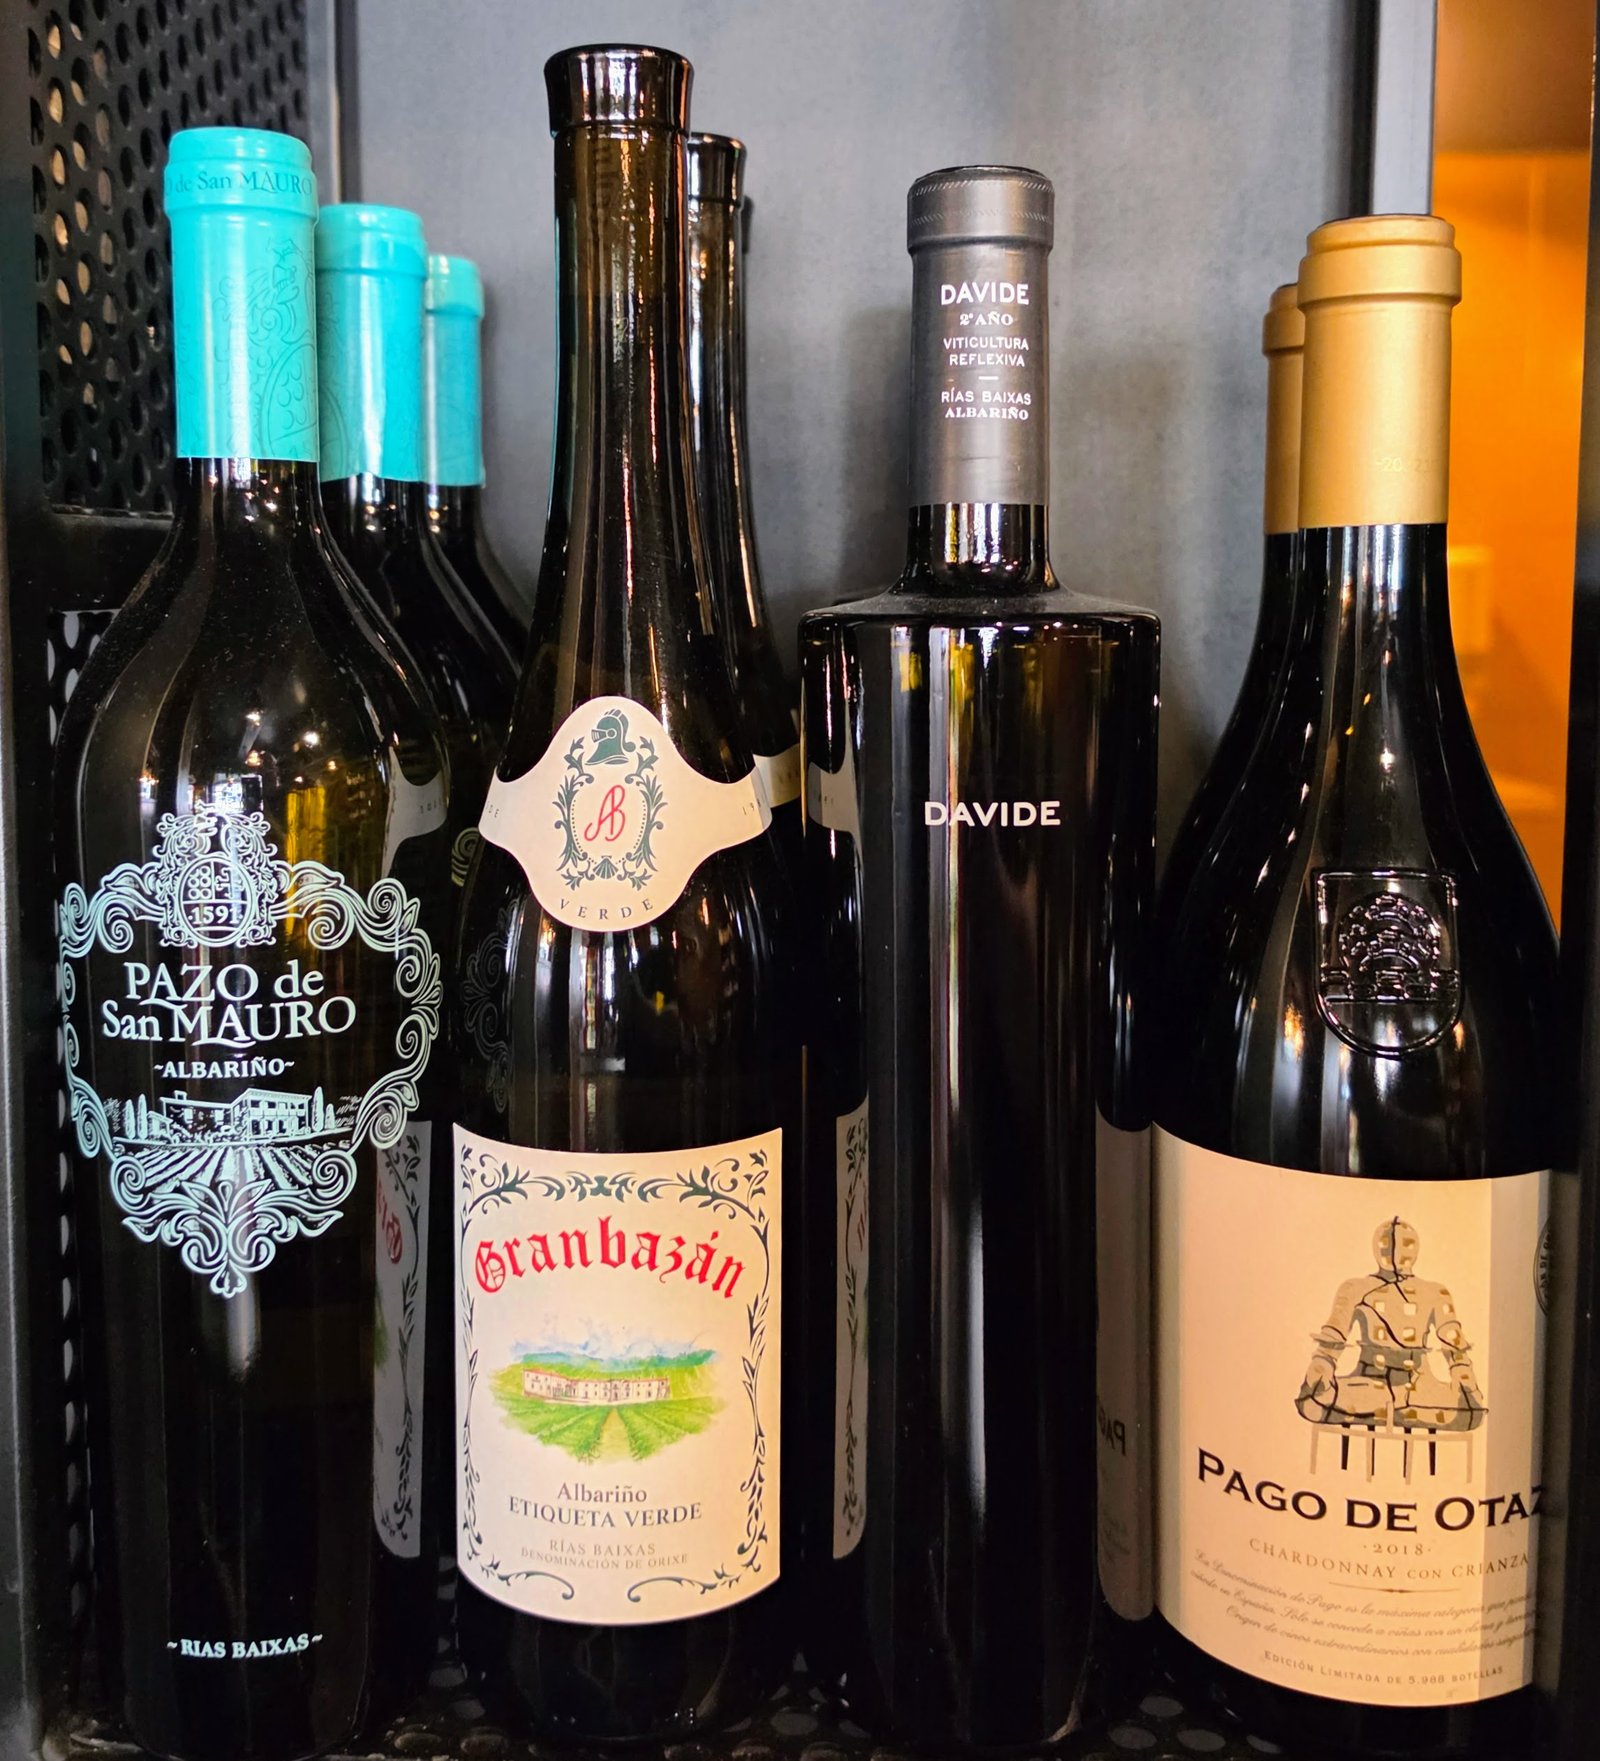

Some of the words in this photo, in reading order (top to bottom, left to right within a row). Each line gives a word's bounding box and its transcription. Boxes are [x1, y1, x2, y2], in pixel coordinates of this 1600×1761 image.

[176, 173, 192, 193] de
[197, 170, 232, 191] San
[240, 171, 313, 196] MAURO
[941, 281, 1029, 306] DAVIDE
[975, 310, 1014, 326] AÑO
[943, 336, 1029, 351] VITICULTURA
[949, 354, 1025, 367] REFLEXIVA
[941, 386, 975, 403] RÍAS
[982, 391, 1031, 405] BAIXAS
[945, 406, 1029, 420] ALBARIÑO
[924, 801, 1061, 827] DAVIDE
[558, 898, 654, 921] VERDE
[123, 962, 259, 1008] PAZO
[274, 959, 324, 999] de
[102, 1000, 163, 1042] San
[167, 996, 356, 1049] MAURO
[475, 1215, 747, 1299] Granbazán
[557, 1482, 648, 1504] Albariño
[1198, 1447, 1328, 1521] PAGO
[1345, 1497, 1418, 1534] DE
[509, 1495, 616, 1528] ETIQUETA
[624, 1501, 702, 1528] VERDE
[521, 1546, 620, 1570] DENOMINACIÓN
[626, 1559, 642, 1570] DE
[648, 1553, 688, 1568] ORIXE
[550, 1538, 586, 1556] RÍAS
[594, 1542, 656, 1557] BAIXAS
[1249, 1537, 1396, 1579] CHARDONNAY
[1407, 1569, 1441, 1580] CON
[1452, 1552, 1530, 1578] CRIANZA
[1263, 1650, 1315, 1673] EDICIÓN
[1319, 1664, 1380, 1684] LIMITADA
[1387, 1676, 1401, 1685] DE
[1451, 1666, 1504, 1684] BOTELLAS
